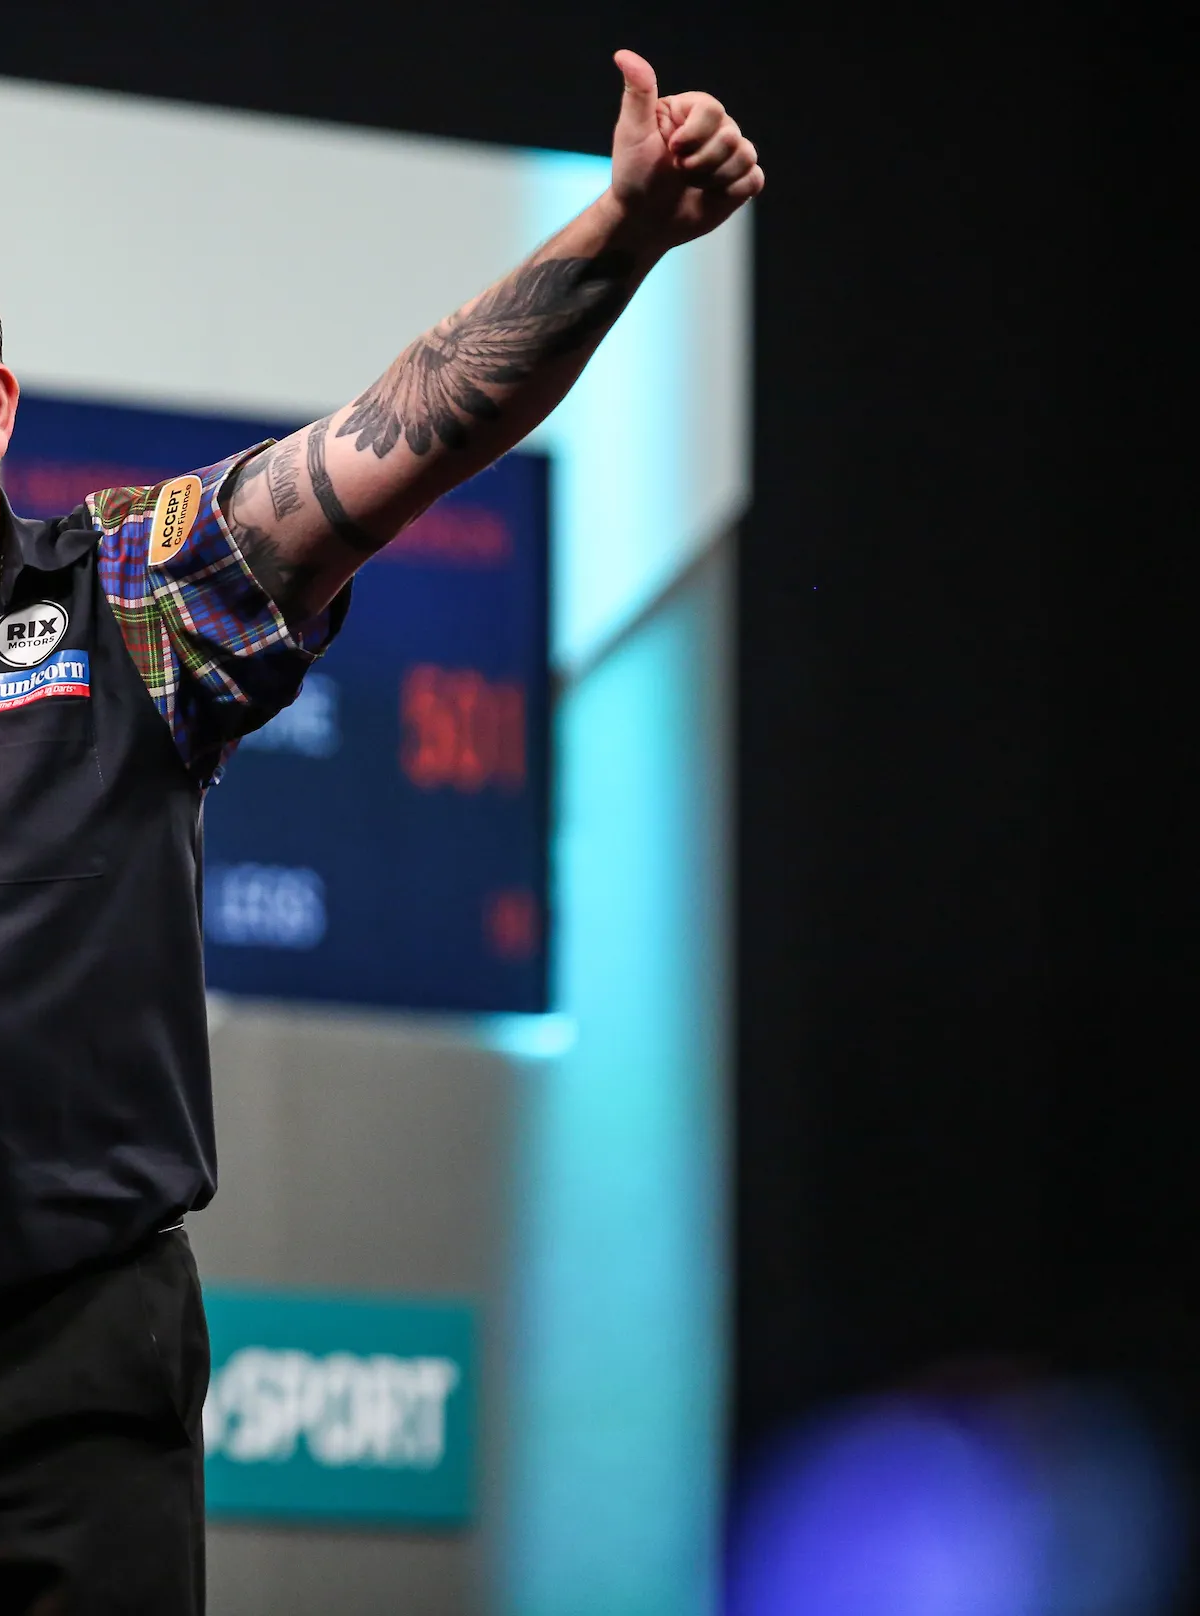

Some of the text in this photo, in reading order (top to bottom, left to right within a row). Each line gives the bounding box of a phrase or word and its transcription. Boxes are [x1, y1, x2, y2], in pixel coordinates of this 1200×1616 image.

[161, 489, 182, 548] ACCEPT
[174, 484, 192, 545] Car Finance
[7, 616, 58, 641] RIX
[8, 636, 55, 650] MOTORS
[0, 661, 85, 698] unicorn
